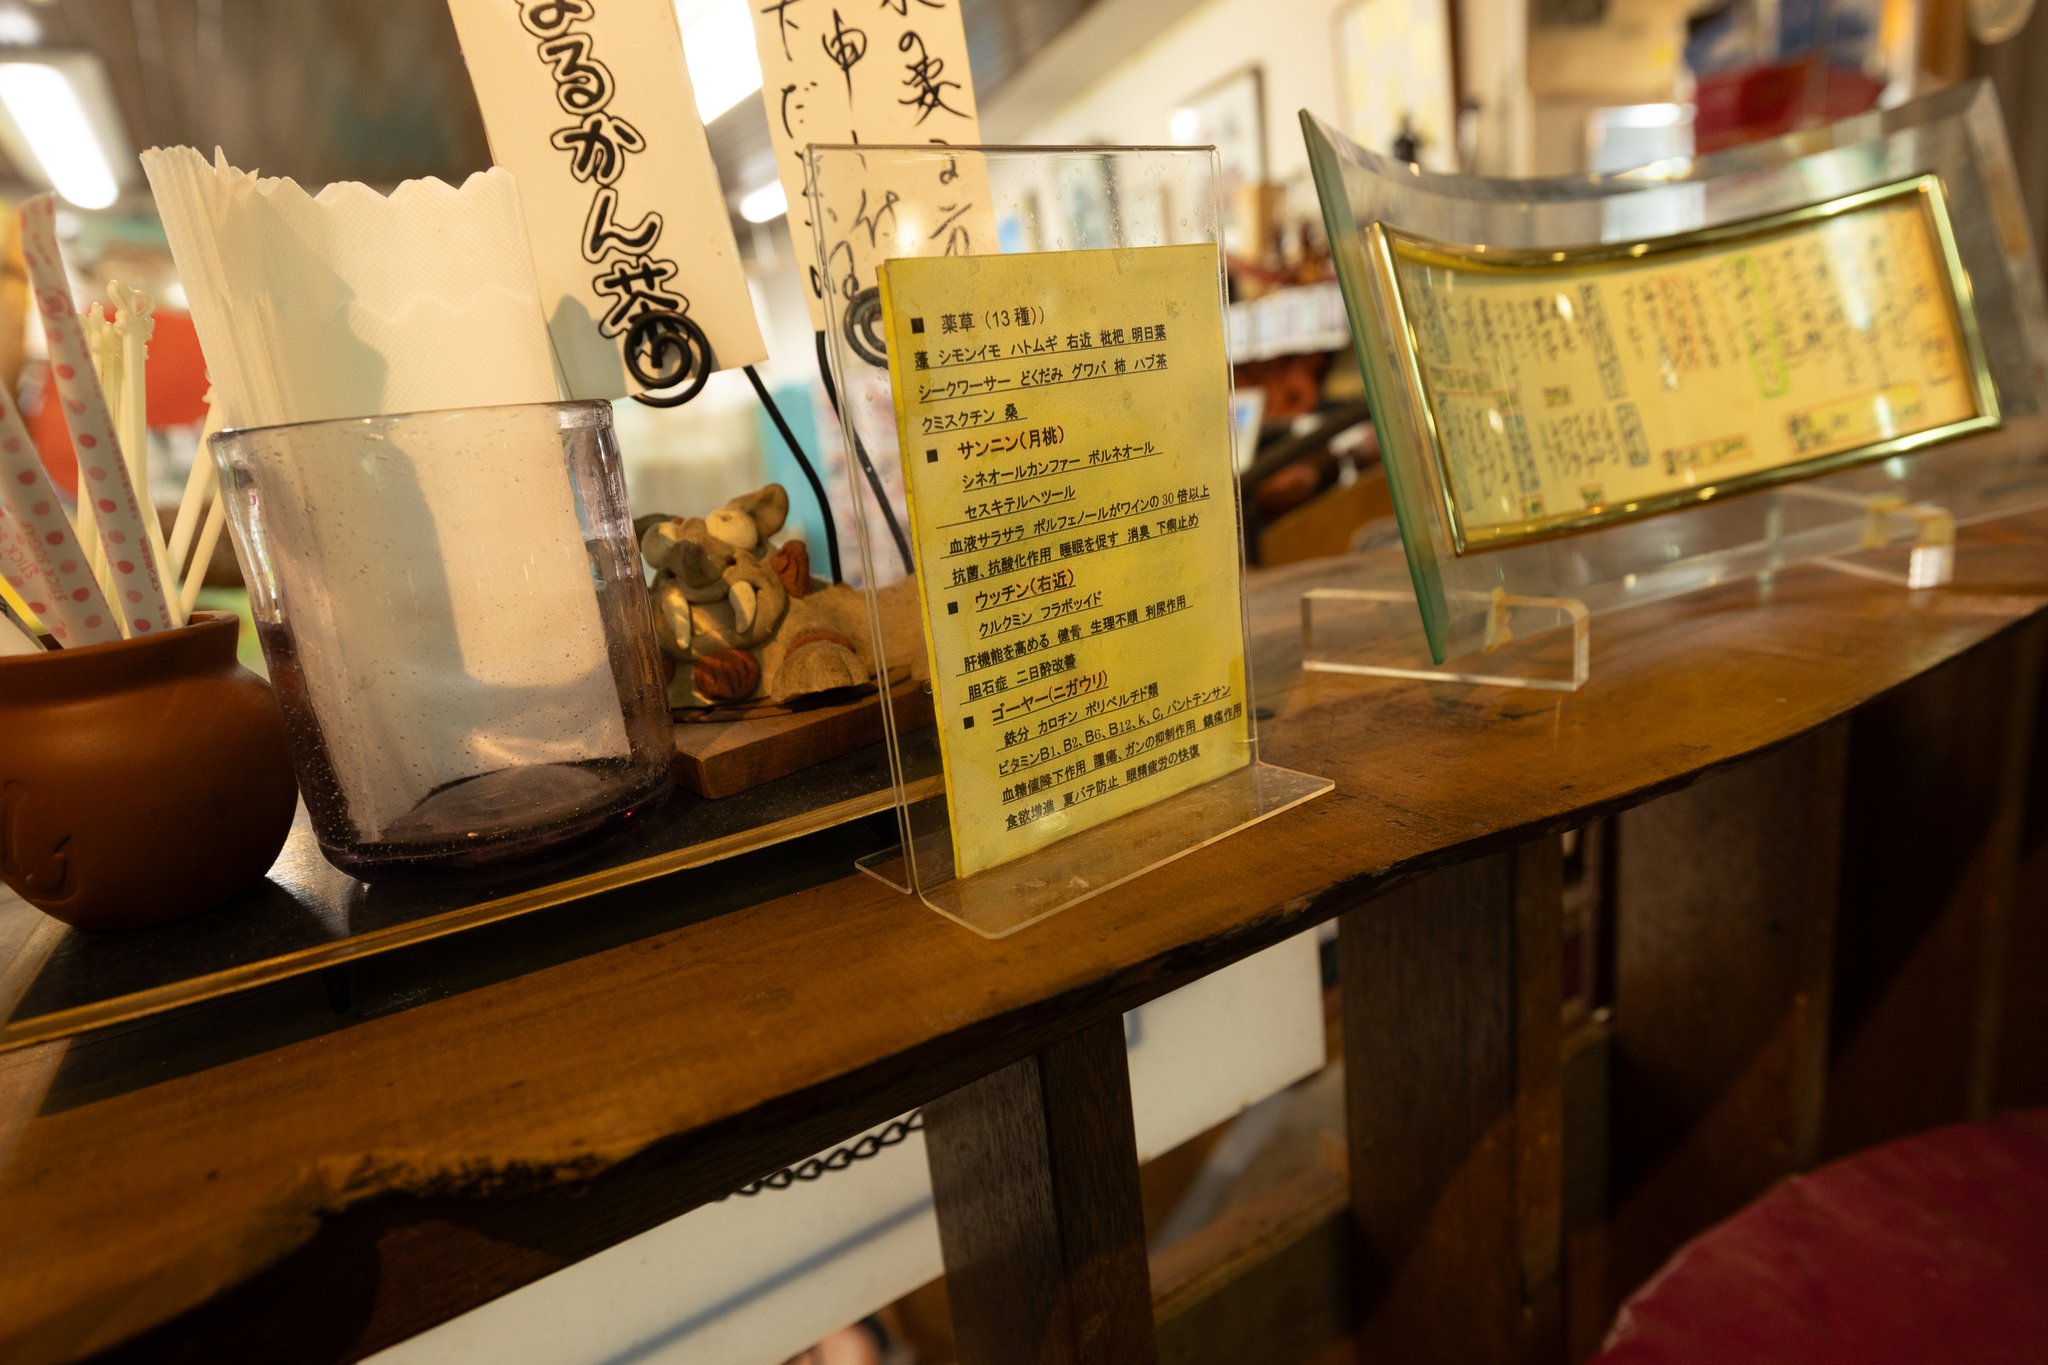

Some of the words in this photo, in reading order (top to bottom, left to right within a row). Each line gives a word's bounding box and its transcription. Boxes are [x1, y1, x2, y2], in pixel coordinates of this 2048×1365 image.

[938, 344, 1001, 365] シモンイモ
[1010, 335, 1058, 356] ハトムギ
[1066, 330, 1093, 350] 右近
[1100, 328, 1125, 346] 枇杷
[1131, 323, 1167, 342] 明日葉
[941, 311, 976, 335] 薬草
[919, 375, 1011, 401] シークワーサー
[1020, 367, 1063, 387] どくだみ
[1134, 353, 1168, 370] ハブ茶
[922, 409, 995, 433] クミスクチン
[1004, 402, 1018, 420] 桑
[962, 458, 1081, 489] シネオールカンファー
[1088, 441, 1155, 465] ボルネオール
[950, 525, 1025, 555] 血液サラサラ
[952, 547, 1052, 585] 抗菌、抗酸化作用
[1059, 531, 1119, 558] 睡眠を促す
[1127, 524, 1150, 542] 消臭
[1156, 513, 1199, 534] 下痢止め
[963, 633, 1050, 672] 肝機能を高める
[1090, 609, 1138, 634] 生理不順
[1145, 594, 1186, 619] 利尿作用
[979, 612, 1032, 637] クルクミン
[968, 675, 1009, 700] 胆石症
[1017, 653, 1076, 684] 二日酔改善
[1002, 760, 1087, 802] 血糖値降下作用
[1203, 703, 1242, 728] 鎮痛作用
[1004, 726, 1029, 747] 鉄分
[1037, 711, 1078, 735] カロチン
[1005, 799, 1056, 830] 食欲増進
[1063, 776, 1119, 807] 夏バテ防止
